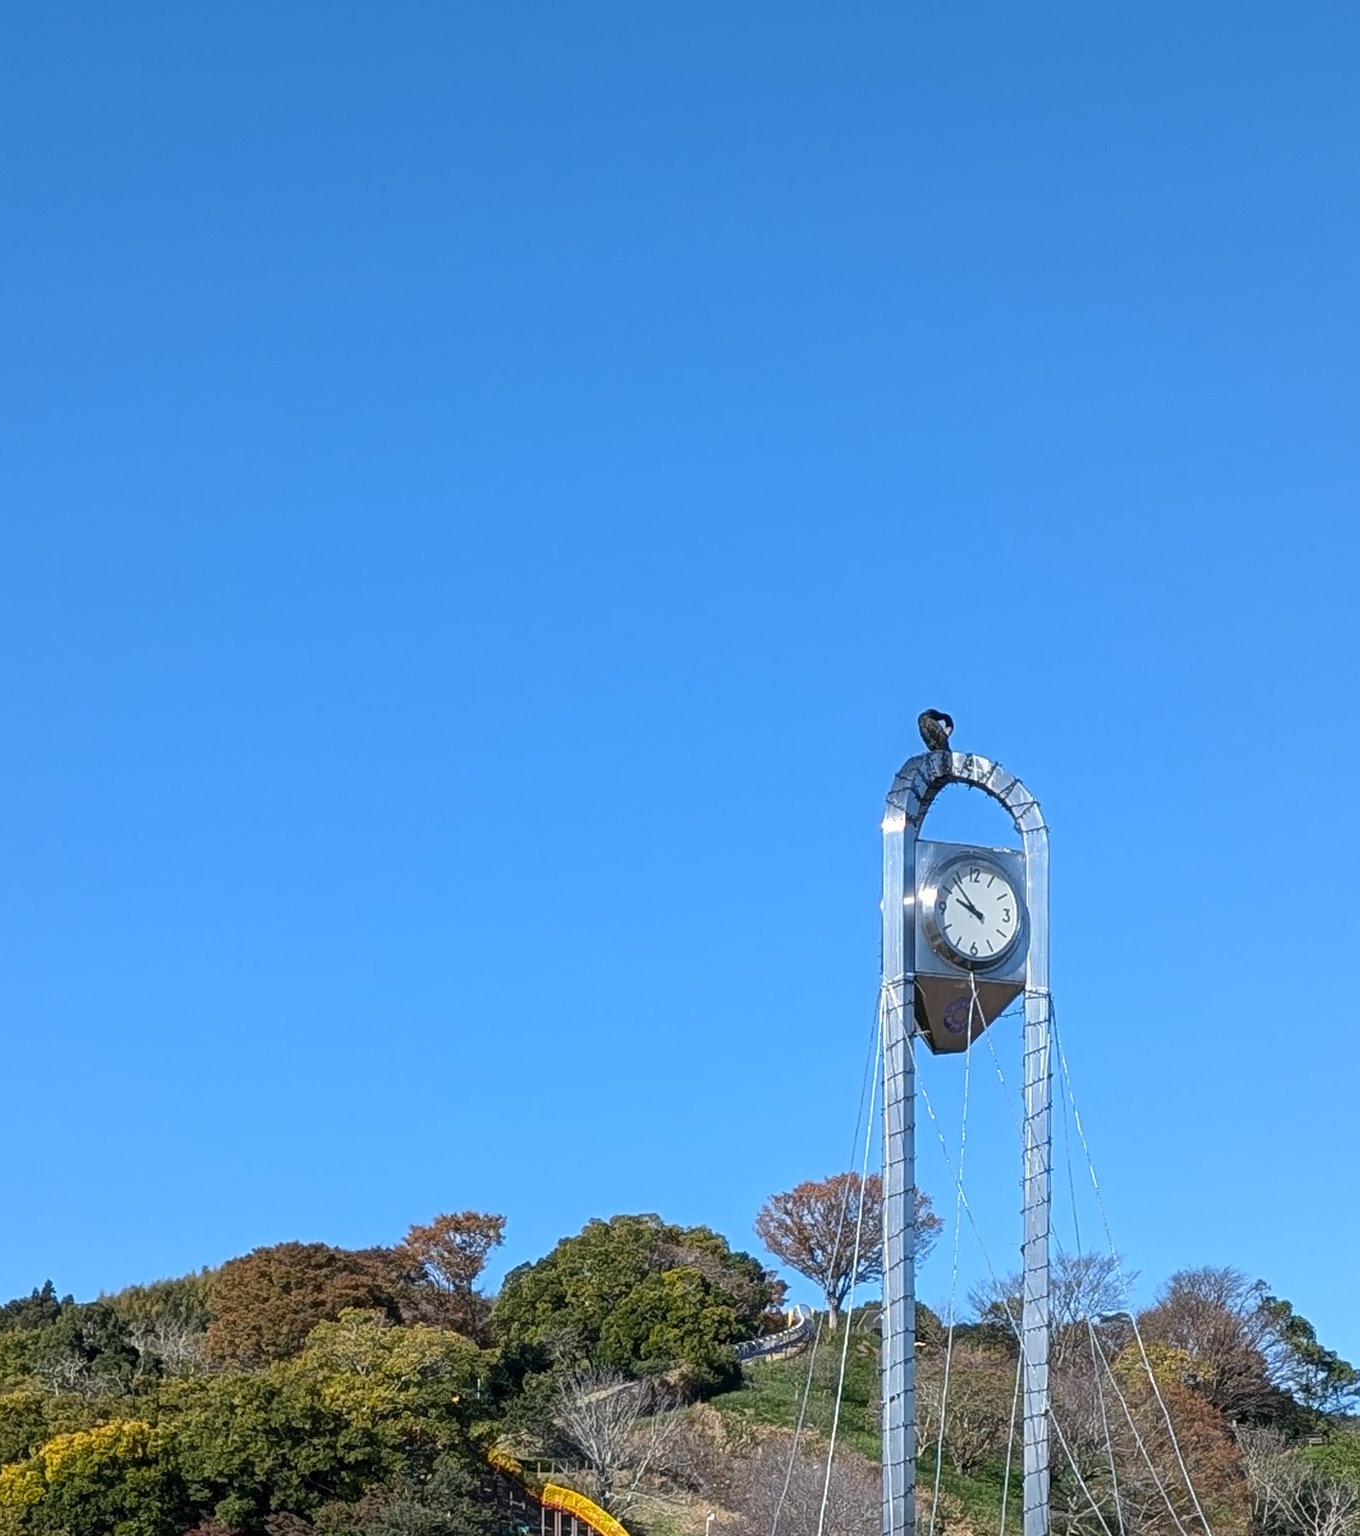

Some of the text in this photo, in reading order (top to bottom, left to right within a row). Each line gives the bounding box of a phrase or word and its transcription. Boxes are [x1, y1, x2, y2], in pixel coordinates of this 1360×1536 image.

[969, 867, 981, 883] 12
[939, 901, 947, 916] 9
[1002, 908, 1011, 923] 3
[970, 941, 979, 956] 6
